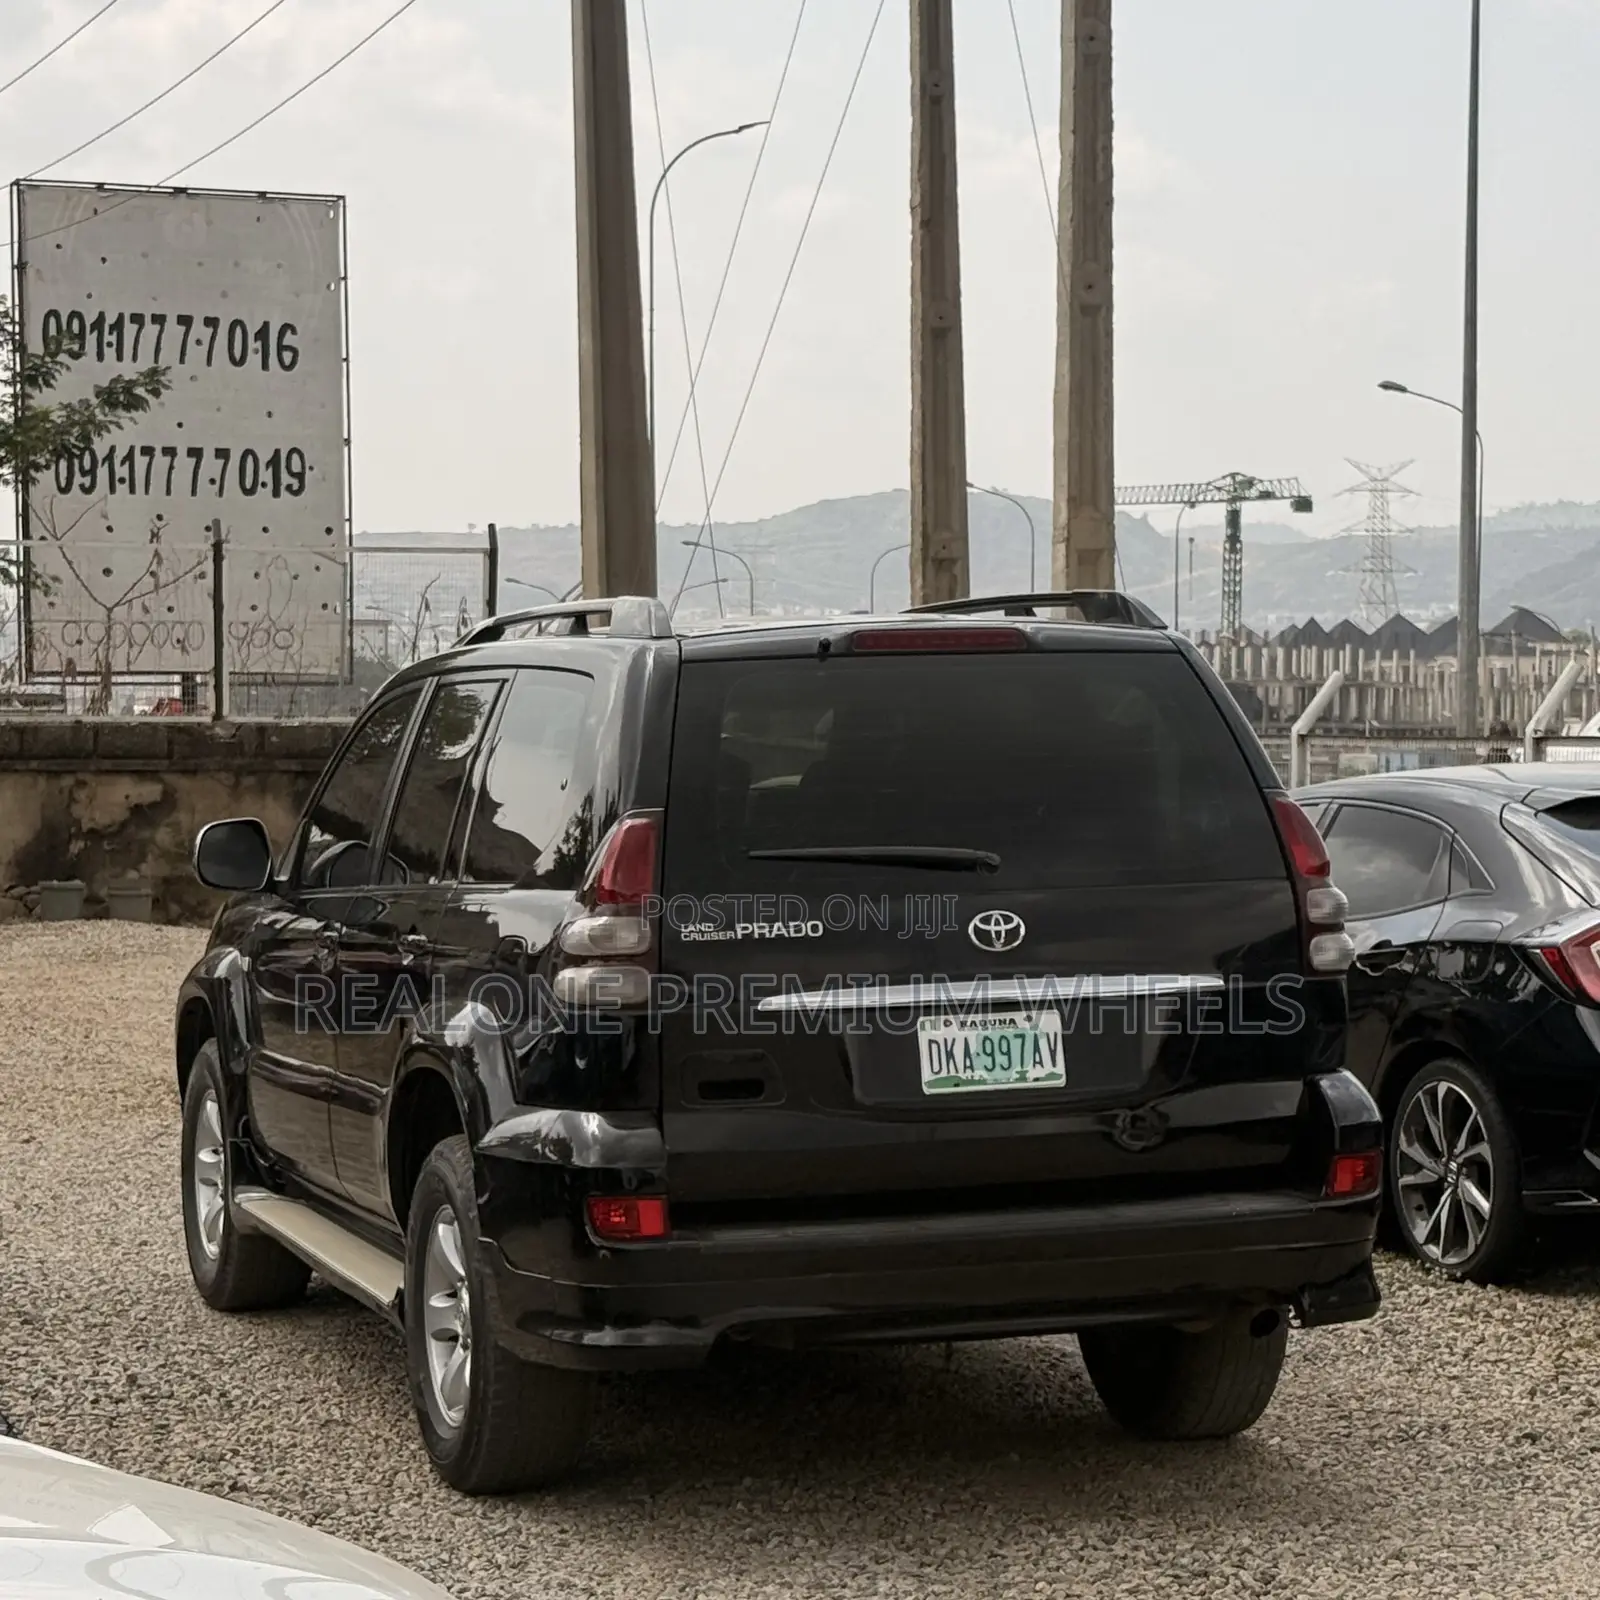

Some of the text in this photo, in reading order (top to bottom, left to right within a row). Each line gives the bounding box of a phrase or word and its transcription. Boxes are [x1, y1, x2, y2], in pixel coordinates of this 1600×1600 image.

[681, 923, 714, 932] LAND
[681, 920, 824, 941] CRUISER PRADO
